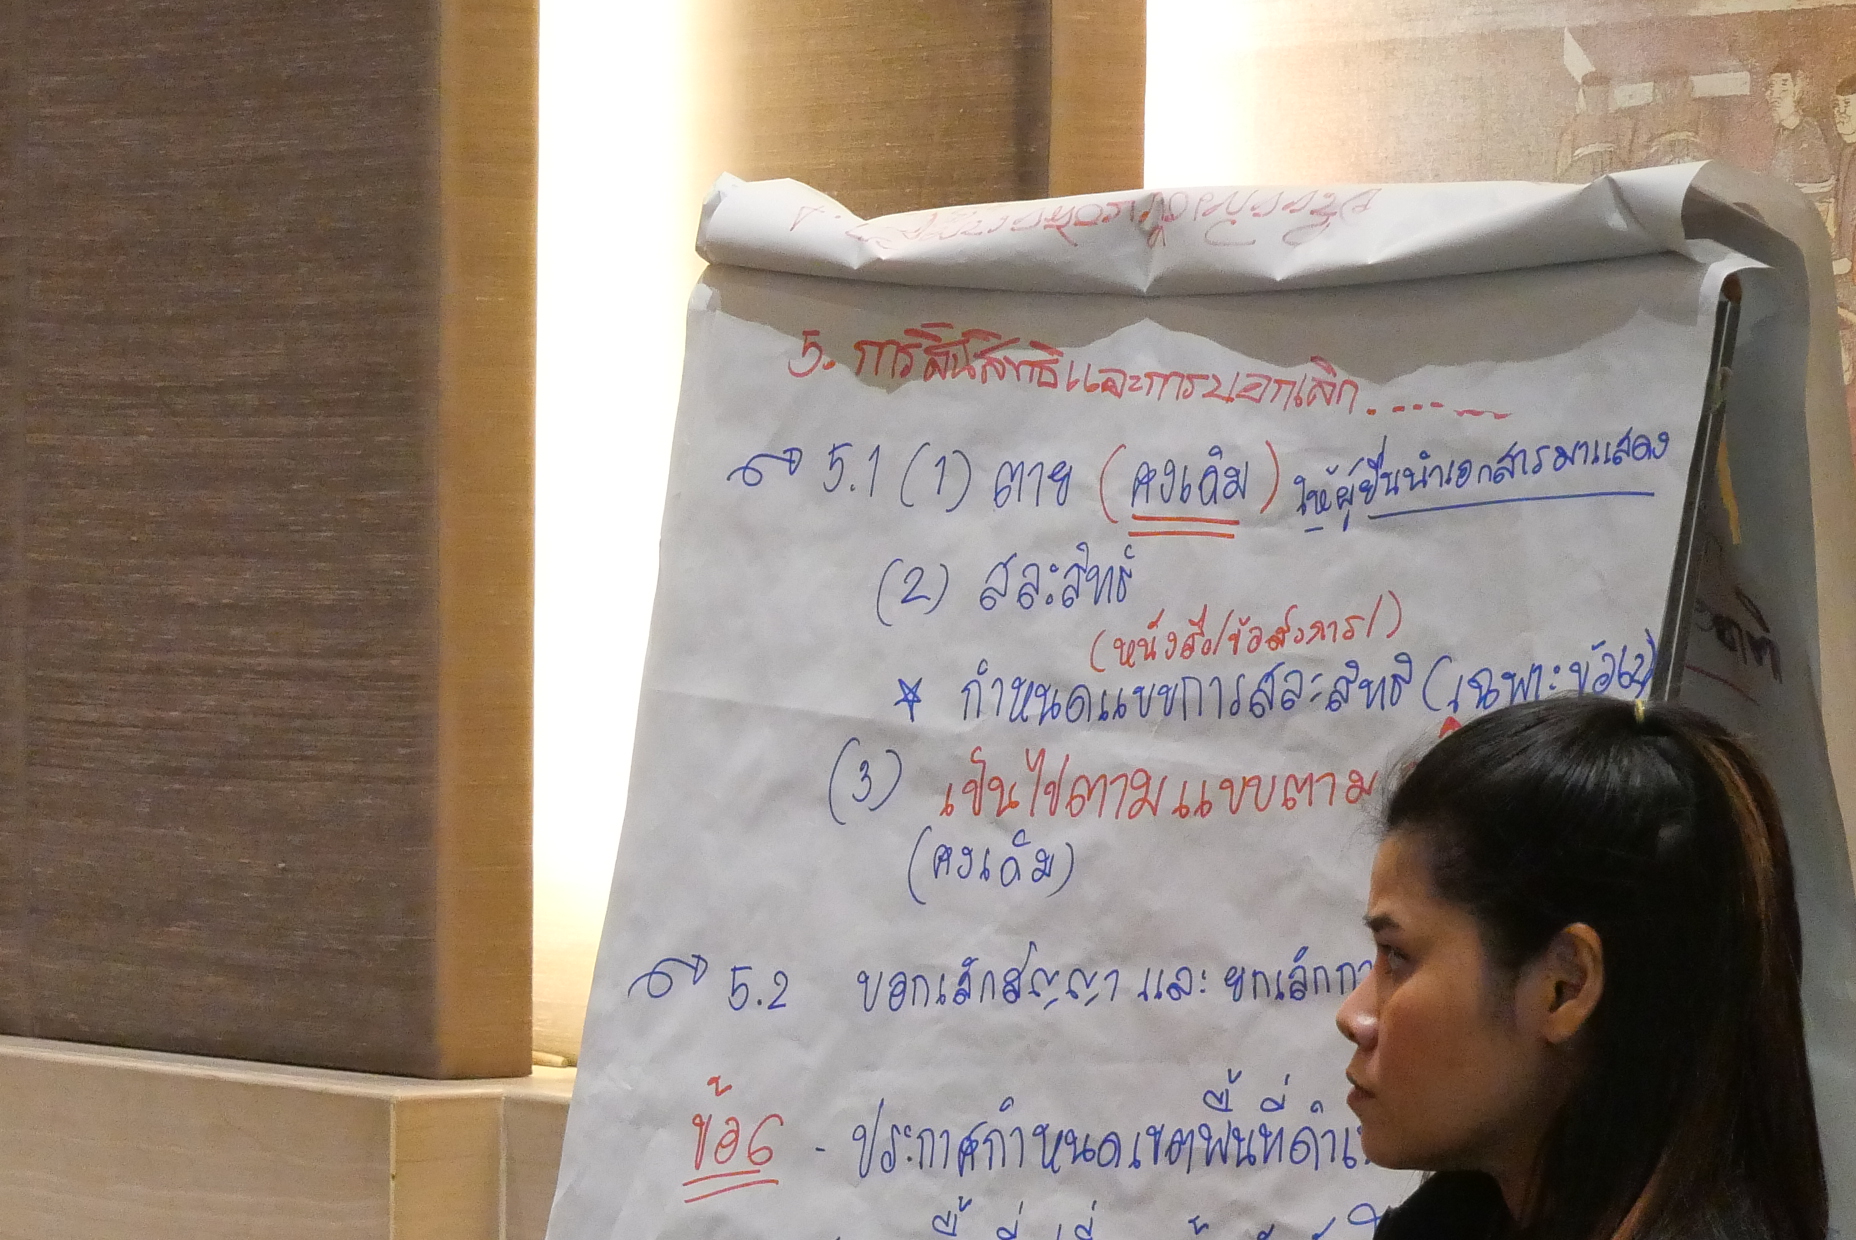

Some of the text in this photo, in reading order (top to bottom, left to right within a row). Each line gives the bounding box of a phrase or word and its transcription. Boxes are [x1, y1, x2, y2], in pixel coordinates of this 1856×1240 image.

[822, 443, 881, 498] 5.1
[900, 442, 971, 513] (1)
[876, 558, 950, 627] (2)
[829, 737, 903, 825] (3)
[729, 965, 790, 1011] 5.2
